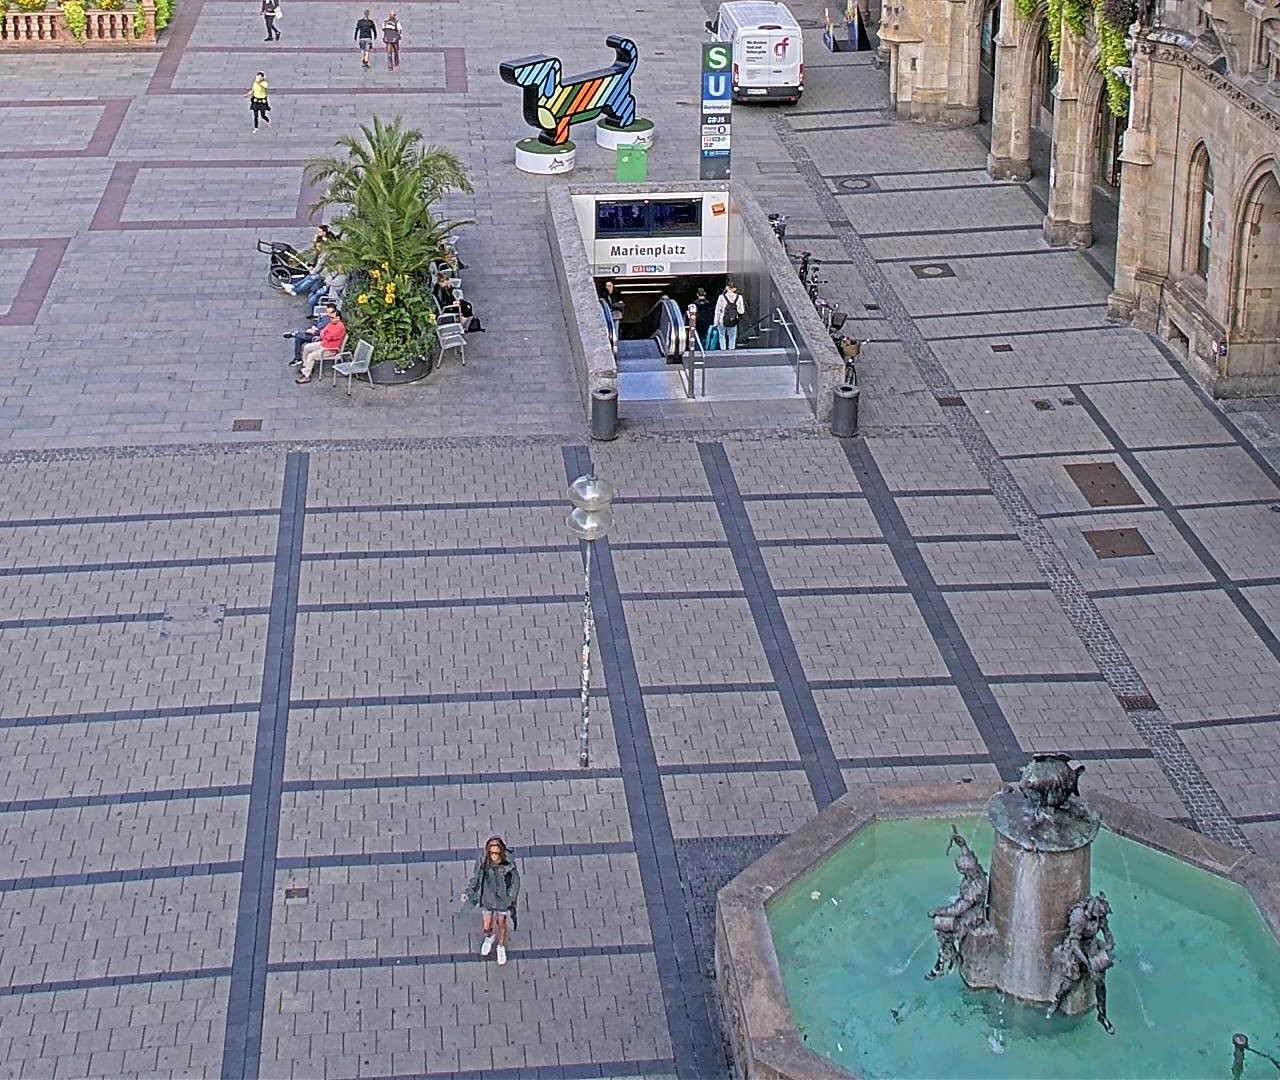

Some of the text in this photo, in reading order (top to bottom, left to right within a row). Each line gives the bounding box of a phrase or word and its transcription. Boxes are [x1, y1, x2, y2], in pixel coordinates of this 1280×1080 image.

[708, 46, 728, 70] S
[708, 75, 726, 97] U
[610, 244, 687, 258] Marienplatz
